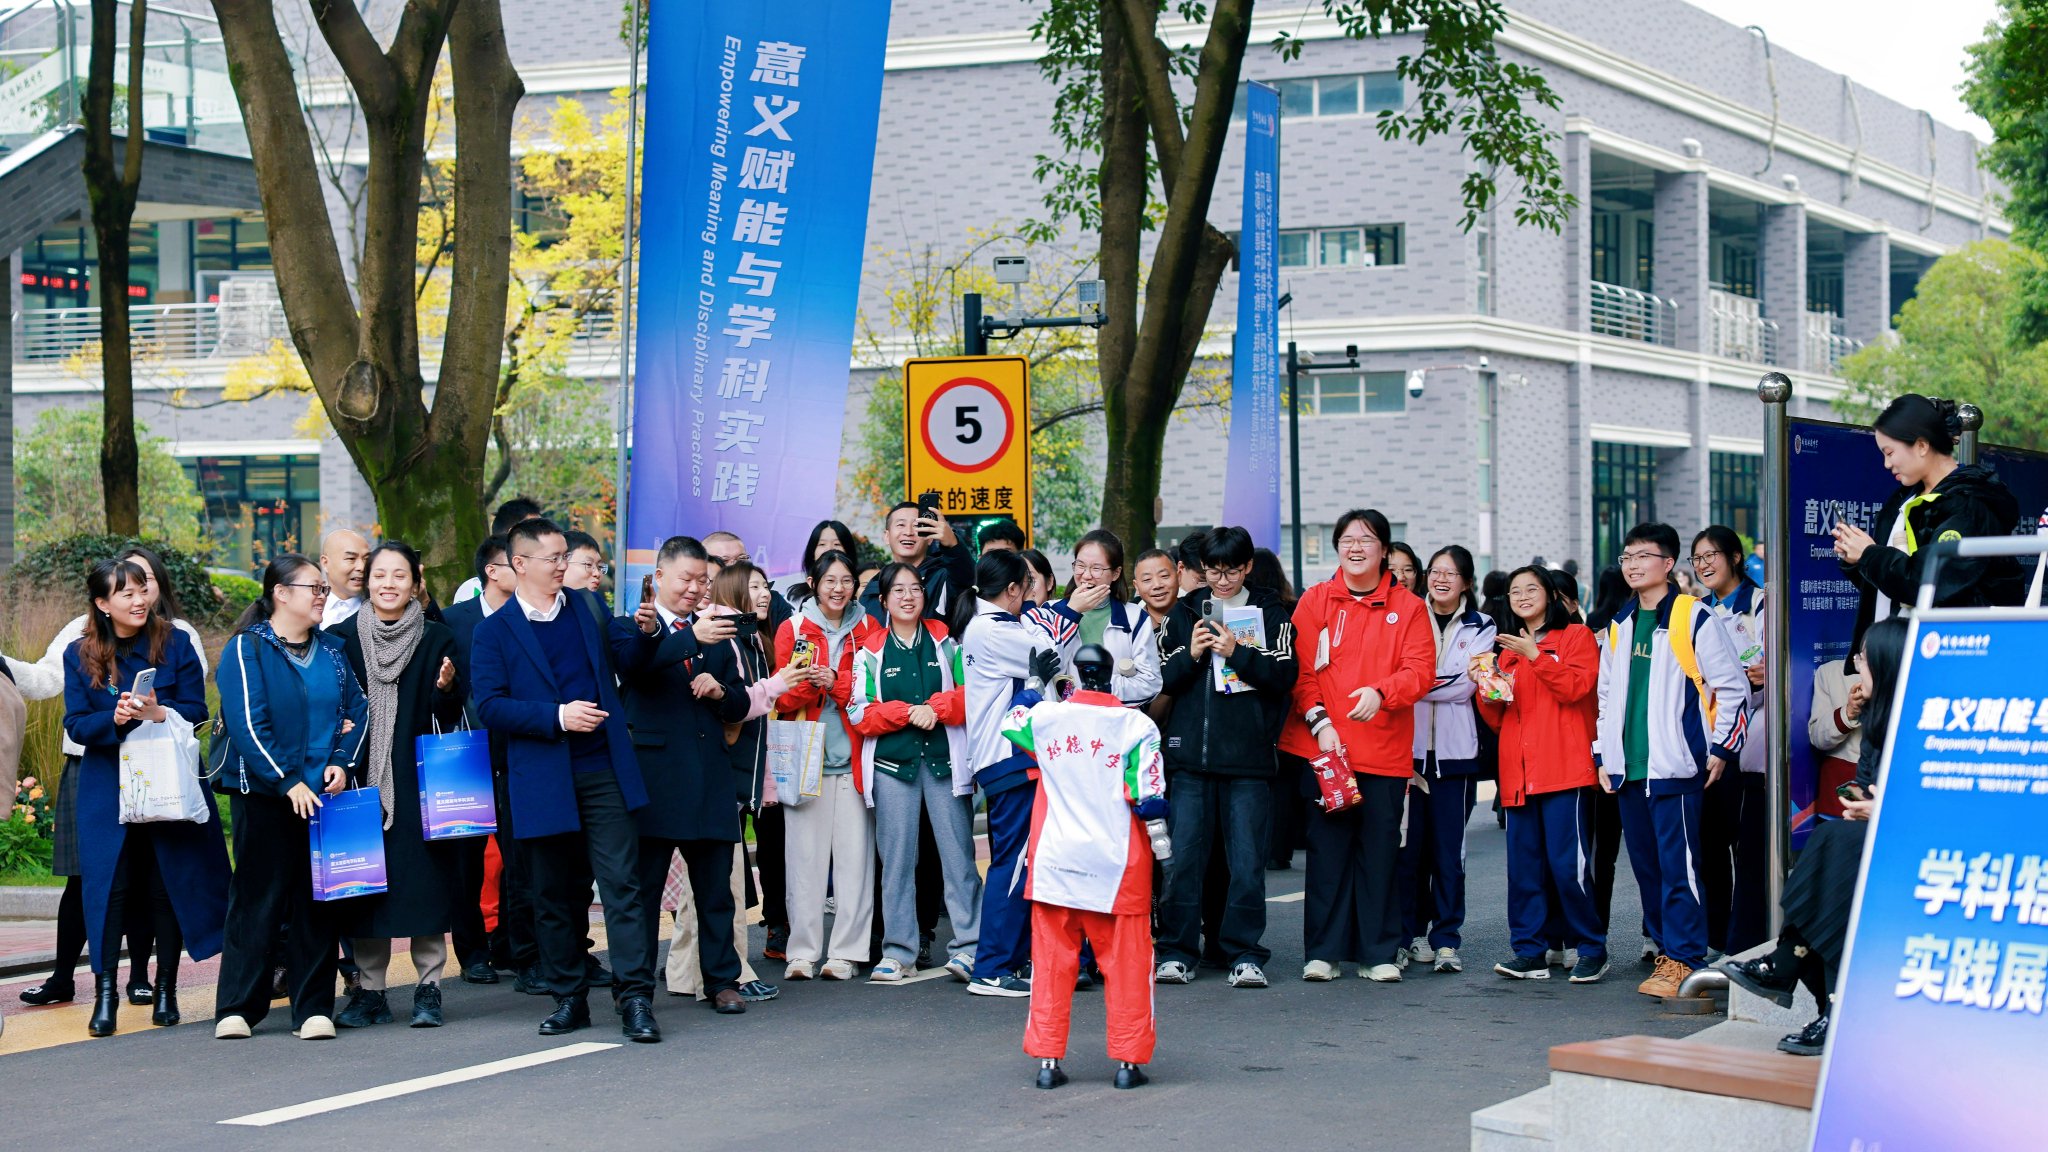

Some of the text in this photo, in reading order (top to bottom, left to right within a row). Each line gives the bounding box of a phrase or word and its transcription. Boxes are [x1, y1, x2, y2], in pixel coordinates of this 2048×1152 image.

[689, 35, 741, 498] Empowering Meaning and Disciplinary Practices
[709, 40, 806, 507] 意义赋能与学科实践
[955, 405, 983, 445] 5
[1924, 735, 1987, 754] Empowering
[1987, 737, 2031, 756] Meaning
[1895, 933, 2048, 1015] 实践展
